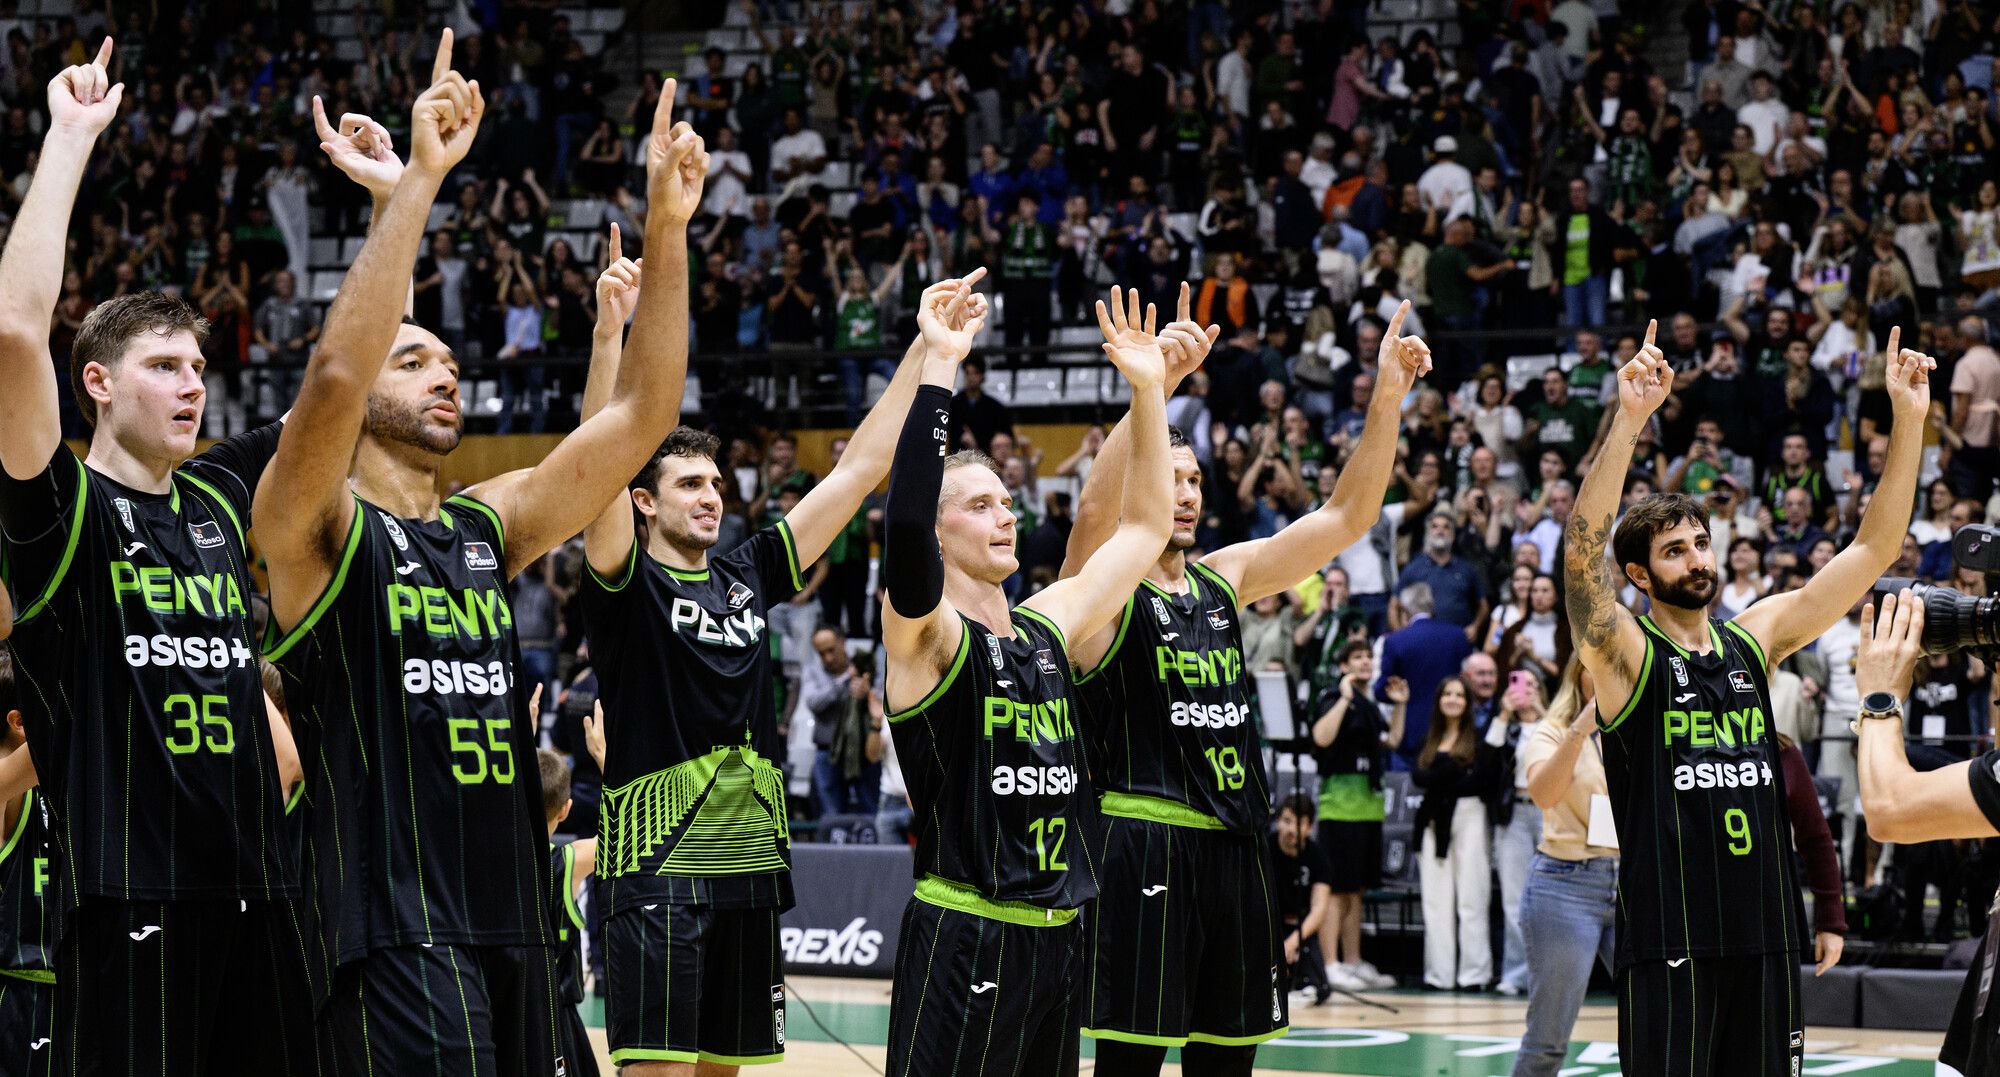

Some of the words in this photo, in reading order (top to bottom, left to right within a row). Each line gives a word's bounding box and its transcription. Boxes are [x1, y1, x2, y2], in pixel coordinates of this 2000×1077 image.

[111, 561, 247, 617] PENYA
[1156, 646, 1241, 688] PENYA
[164, 694, 235, 754] 35
[983, 696, 1076, 747] PENYA
[1663, 707, 1767, 749] PENYA
[448, 719, 515, 784] 55
[1205, 746, 1246, 791] 19
[1028, 817, 1070, 871] 12
[1724, 808, 1752, 856] 9
